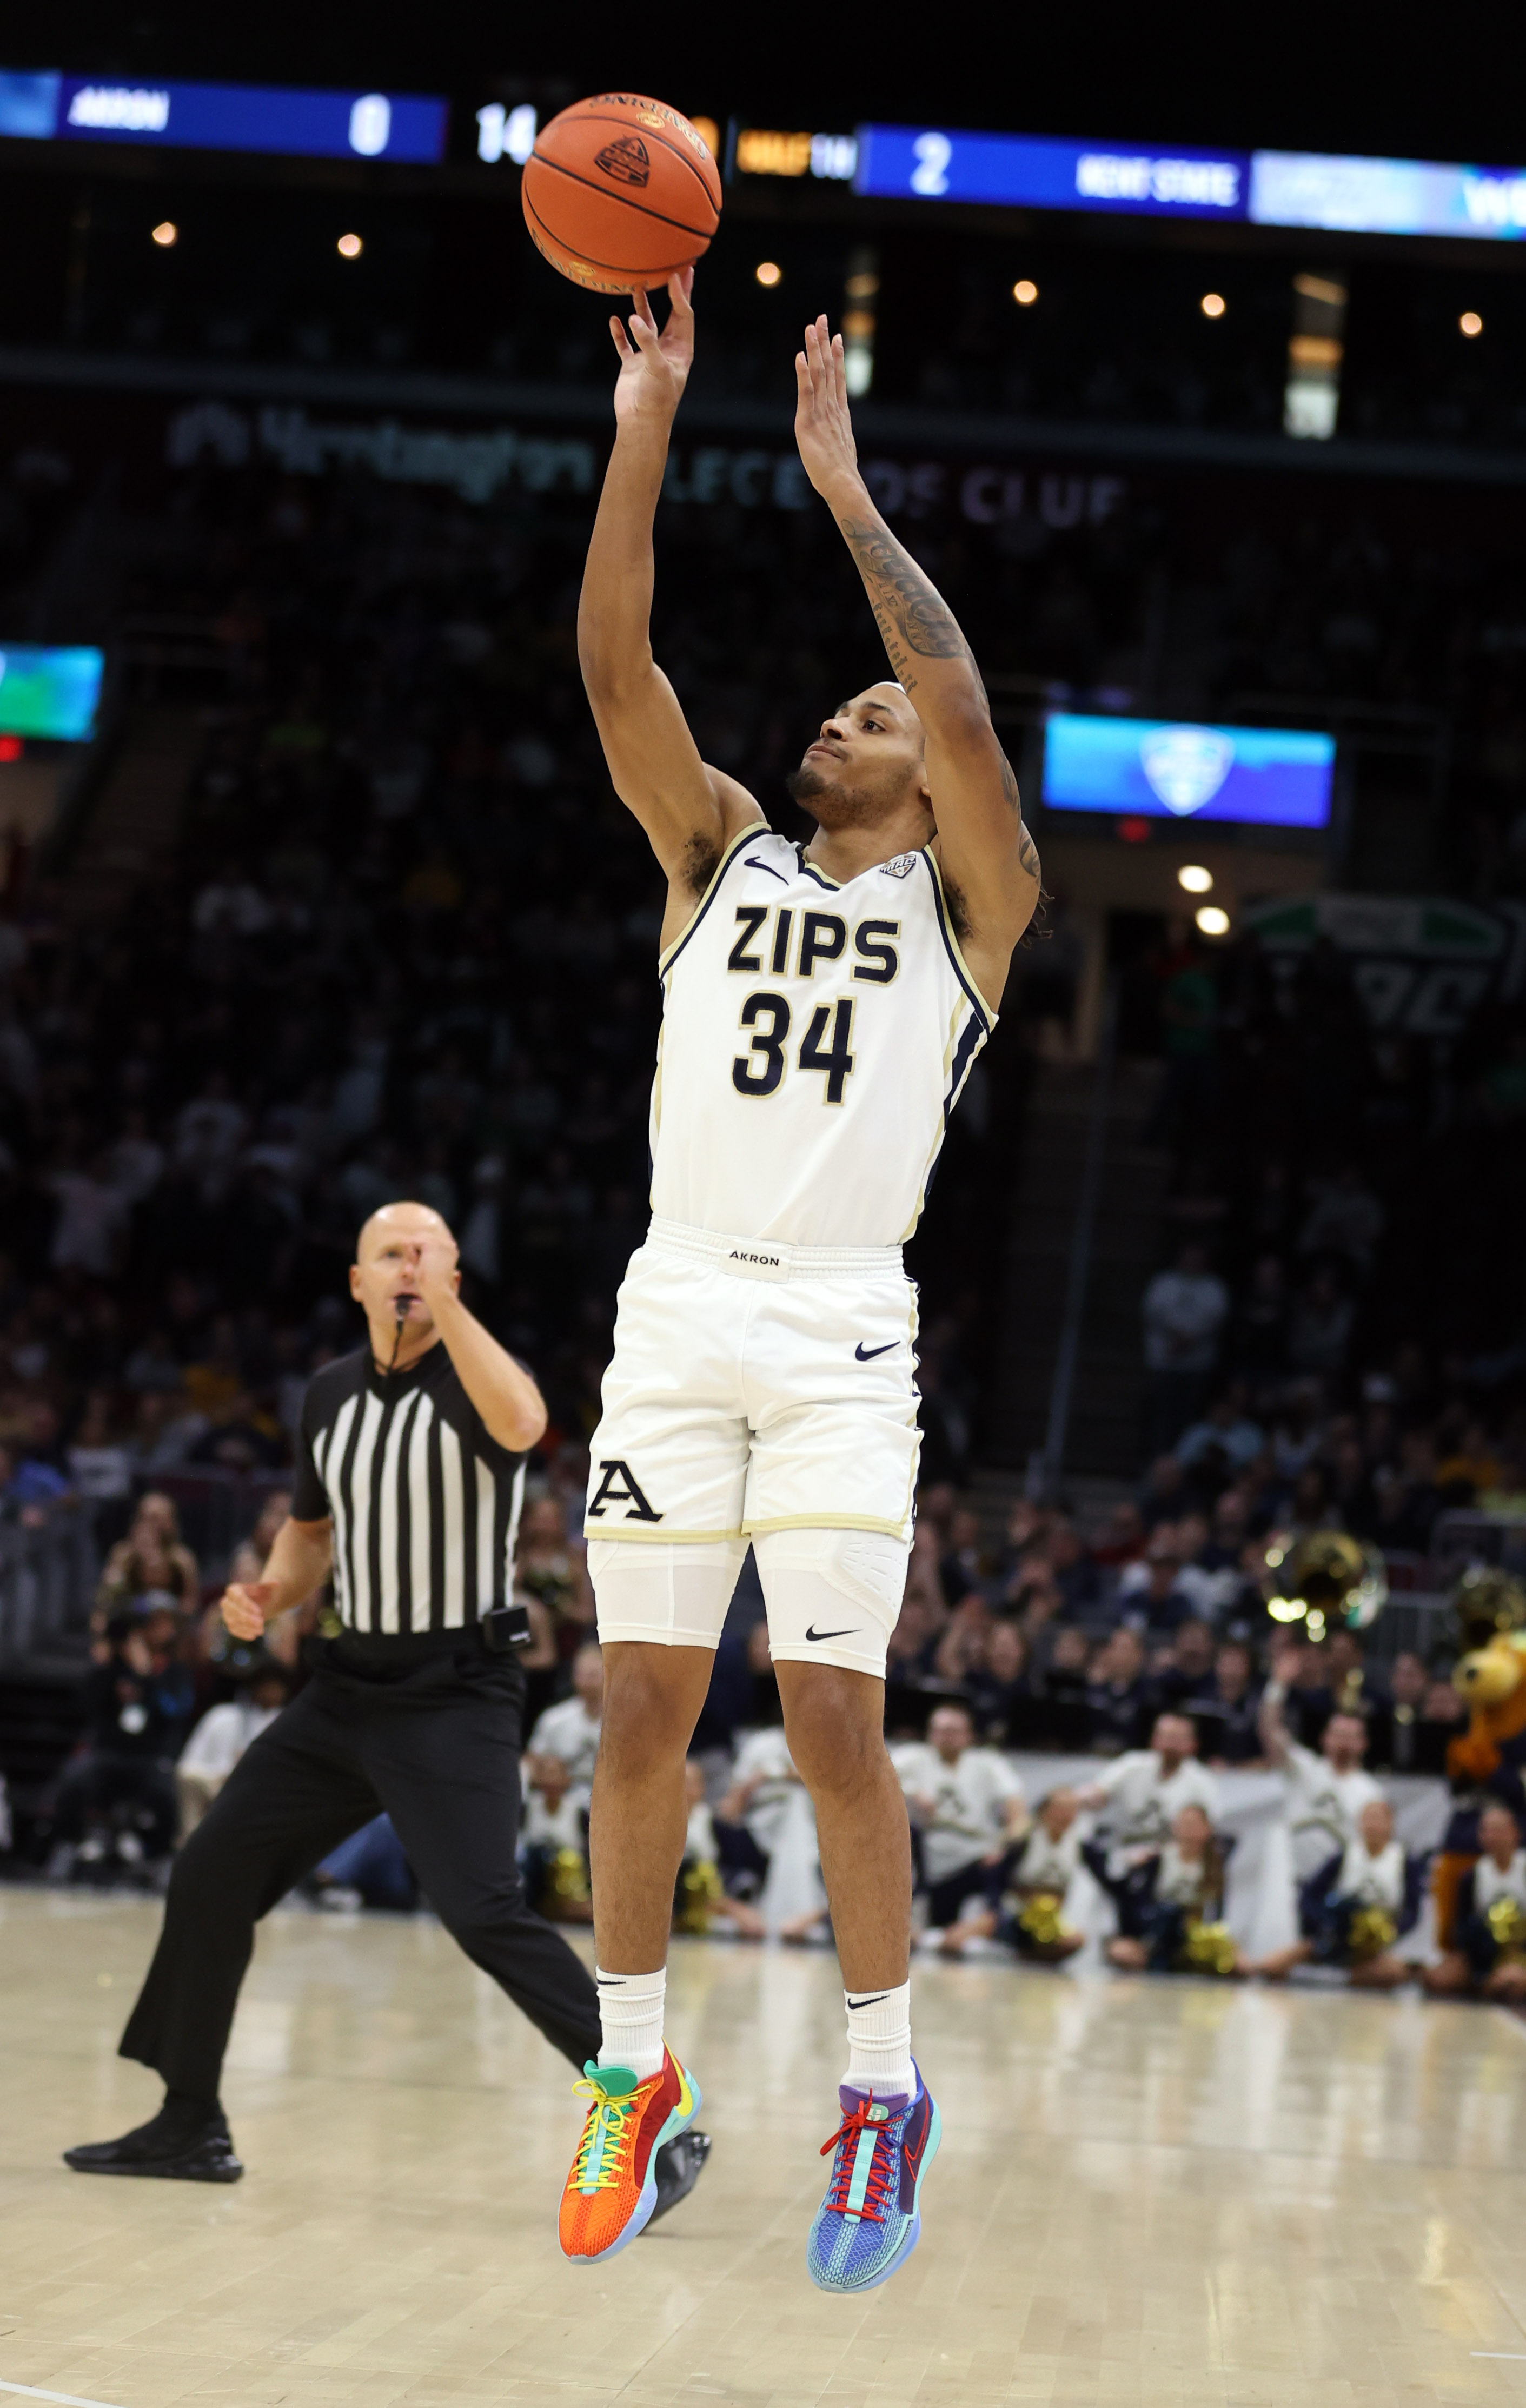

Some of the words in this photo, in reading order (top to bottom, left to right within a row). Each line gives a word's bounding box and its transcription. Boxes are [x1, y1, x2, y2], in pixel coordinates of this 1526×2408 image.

[910, 132, 952, 196] 2
[880, 857, 916, 873] MAC
[727, 904, 901, 987] ZIPS
[730, 989, 858, 1107] 34
[729, 1250, 779, 1266] AKRON
[587, 1459, 667, 1523] A
